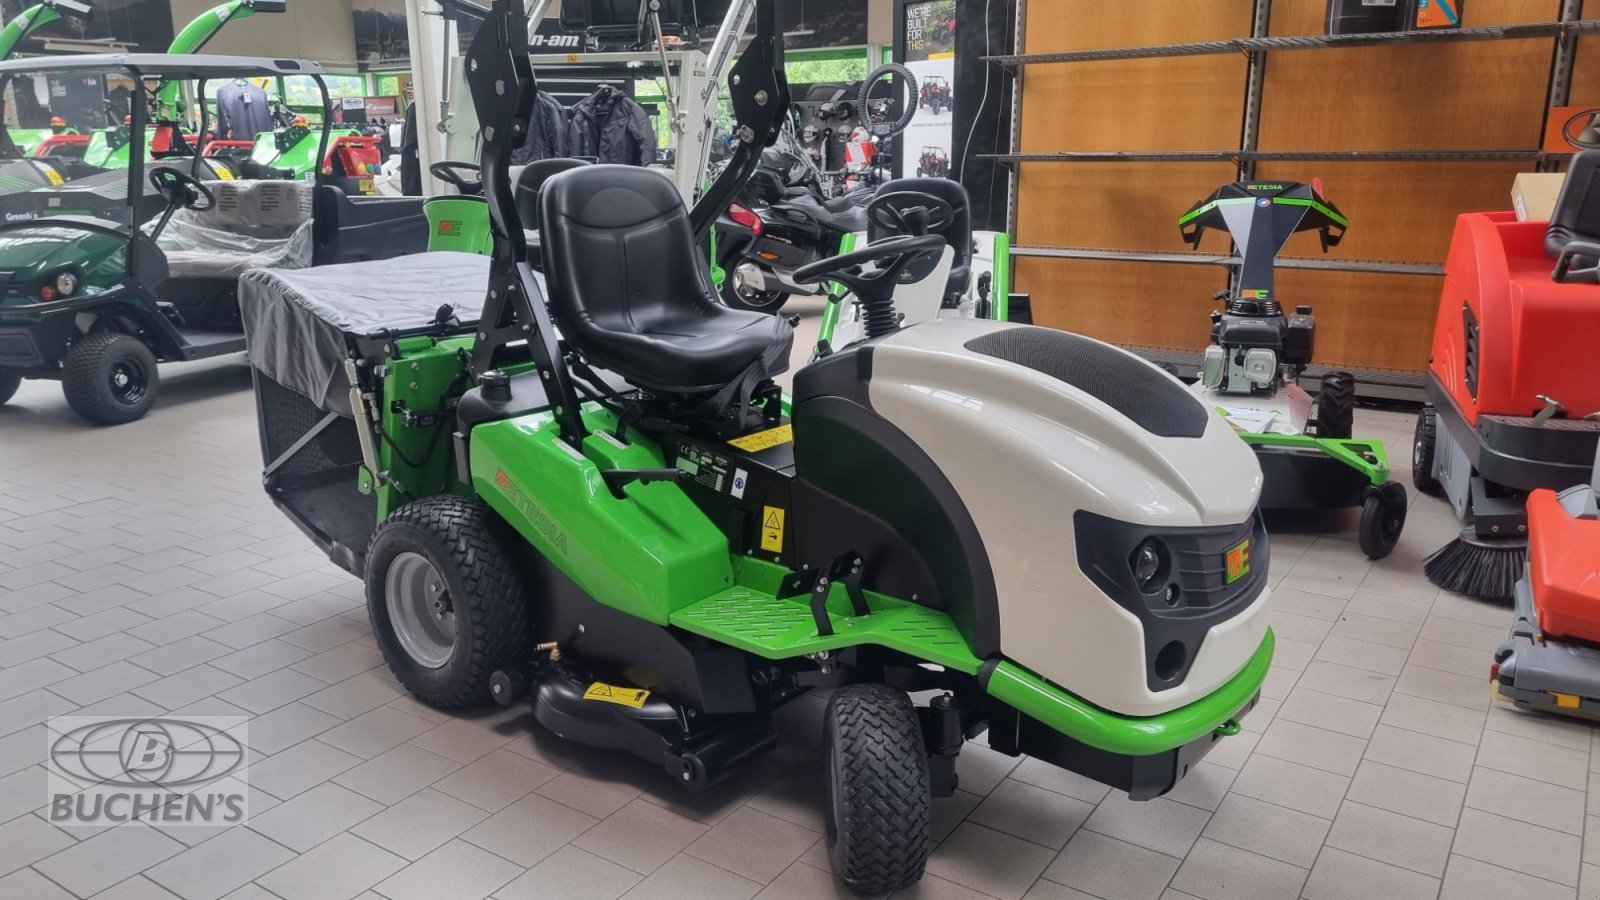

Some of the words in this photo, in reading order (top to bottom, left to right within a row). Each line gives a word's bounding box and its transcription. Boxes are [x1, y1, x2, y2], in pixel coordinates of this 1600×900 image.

[907, 6, 931, 19] WE'RE
[907, 17, 928, 30] BUILT
[907, 29, 922, 41] FOR
[907, 40, 924, 51] THIS
